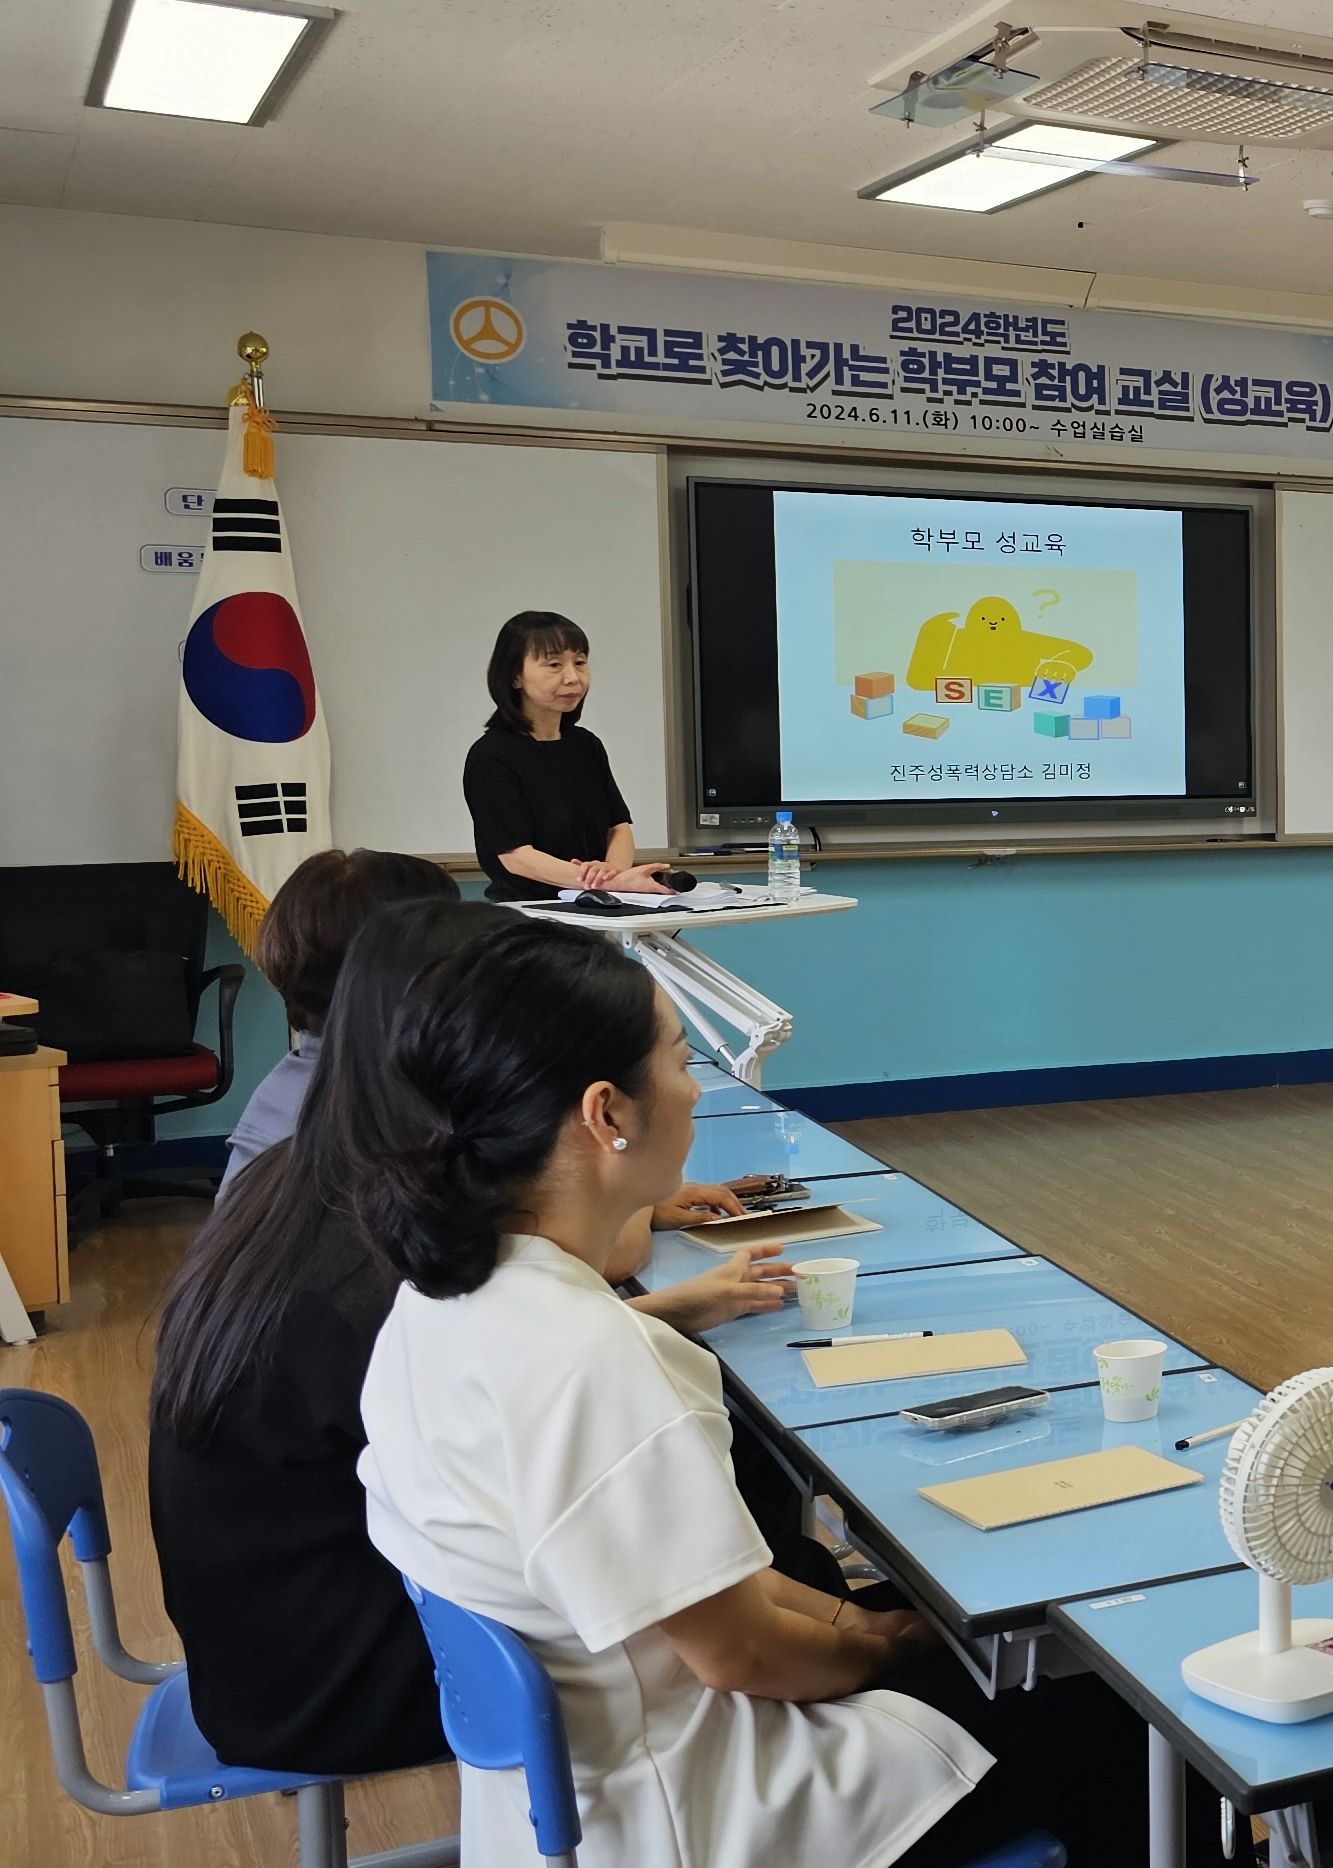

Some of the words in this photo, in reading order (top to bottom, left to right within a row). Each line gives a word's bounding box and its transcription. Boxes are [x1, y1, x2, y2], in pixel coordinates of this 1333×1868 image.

[892, 305, 1068, 348] 2024학년도
[566, 320, 707, 377] 학교로
[717, 332, 890, 390] 찾아가는
[900, 347, 1023, 399] 학부모
[1030, 358, 1107, 406] 참여
[1116, 365, 1192, 412] 교실
[1201, 372, 1332, 425] (성교육)
[806, 402, 959, 431] 2024.6.11.(화)
[970, 414, 1041, 434] 10:00~
[1050, 418, 1144, 443] 수업실습실
[182, 494, 204, 511] 단
[910, 528, 985, 553] 학부모
[996, 530, 1067, 556] 성교육
[154, 551, 204, 568] 배움
[890, 762, 1034, 783] 진주성폭력상담소
[1041, 761, 1092, 782] 김미정
